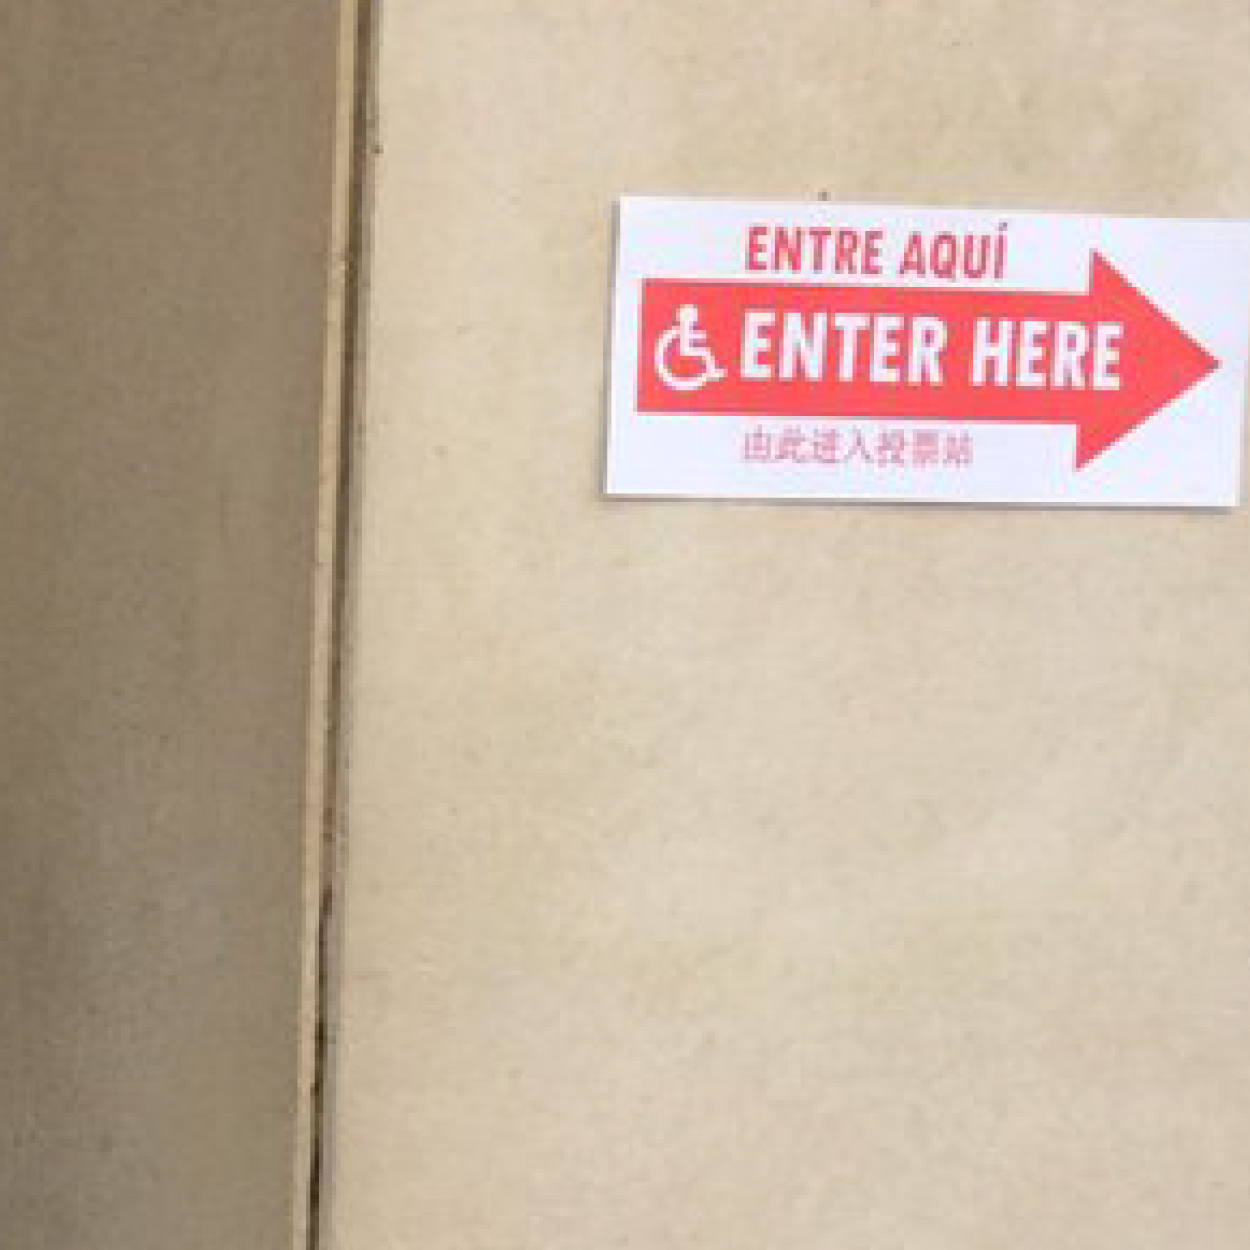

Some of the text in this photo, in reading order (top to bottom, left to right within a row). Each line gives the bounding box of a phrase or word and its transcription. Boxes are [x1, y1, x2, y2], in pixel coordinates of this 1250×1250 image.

[745, 221, 1010, 280] ENTRE AQUÍ
[739, 308, 1124, 391] ENTER HERE
